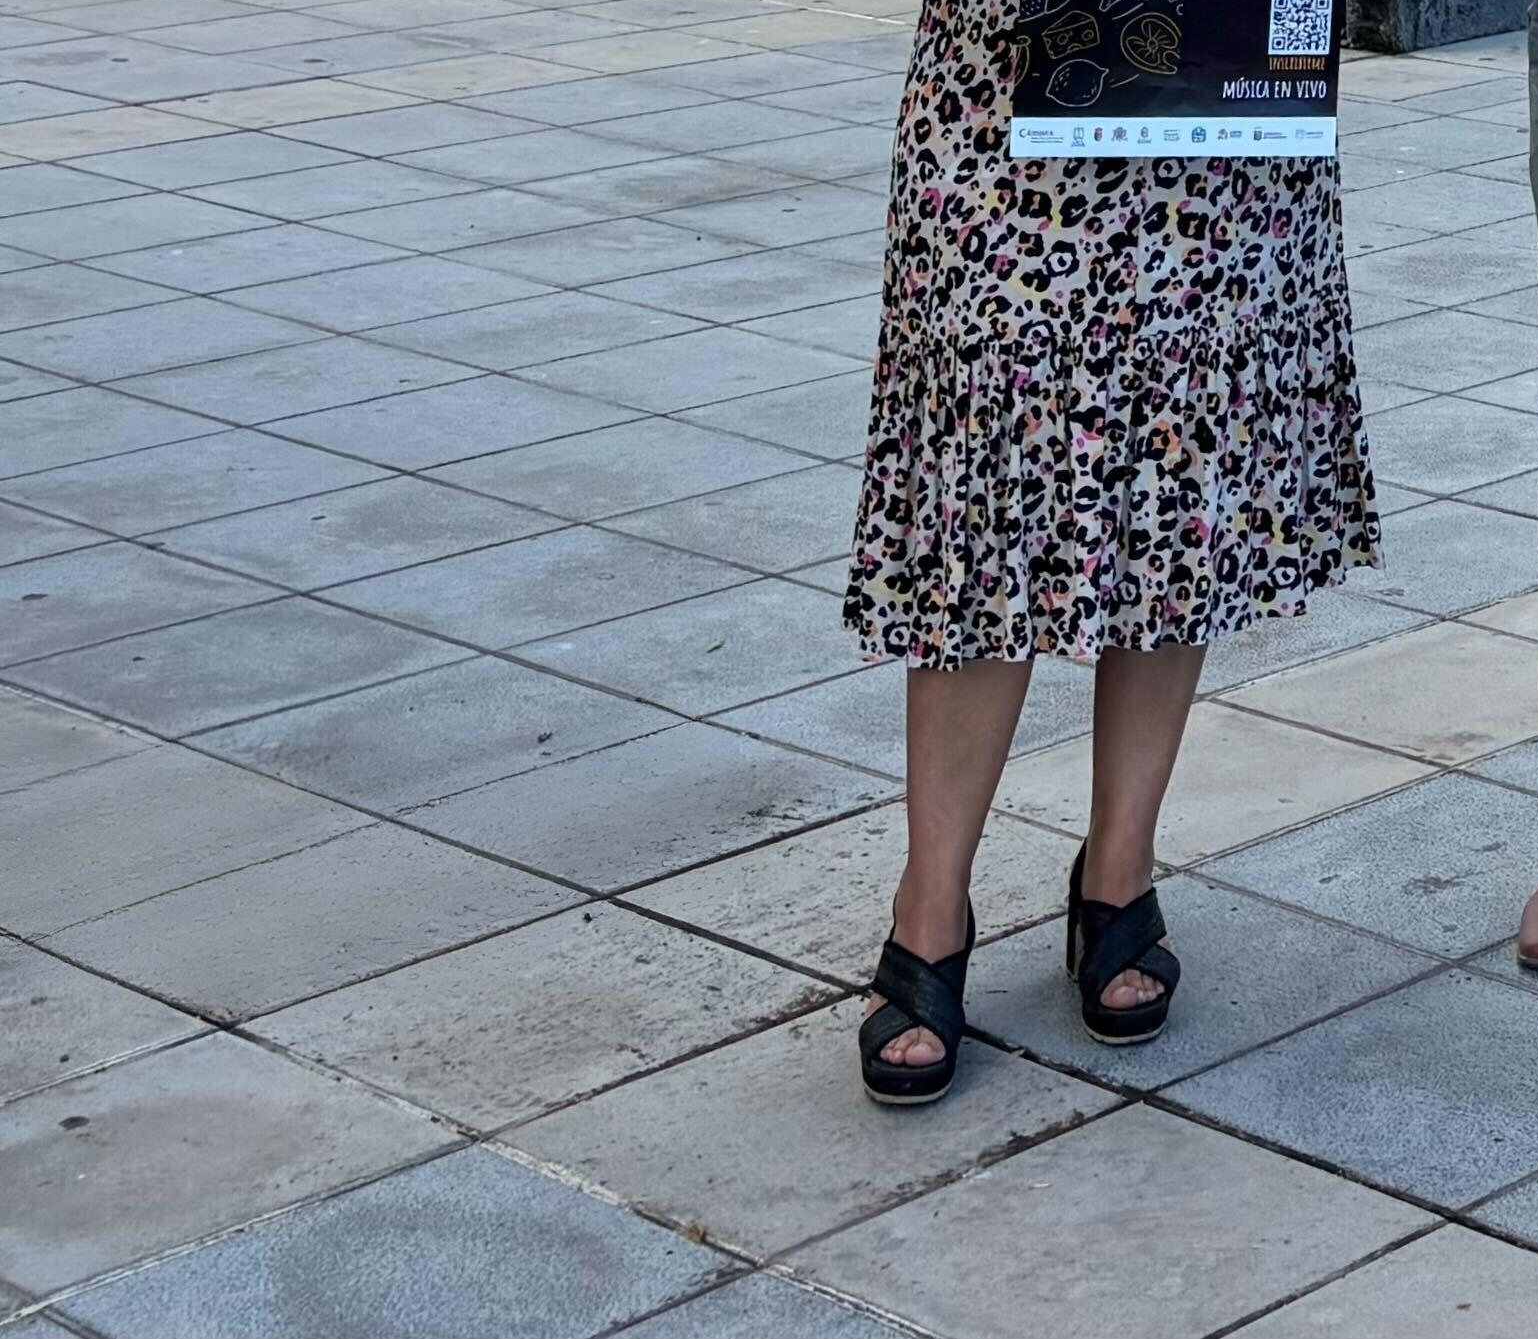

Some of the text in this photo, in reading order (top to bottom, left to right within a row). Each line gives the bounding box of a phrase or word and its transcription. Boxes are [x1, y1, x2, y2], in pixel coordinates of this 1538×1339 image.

[1222, 77, 1327, 98] MÚSICA EN VIVO
